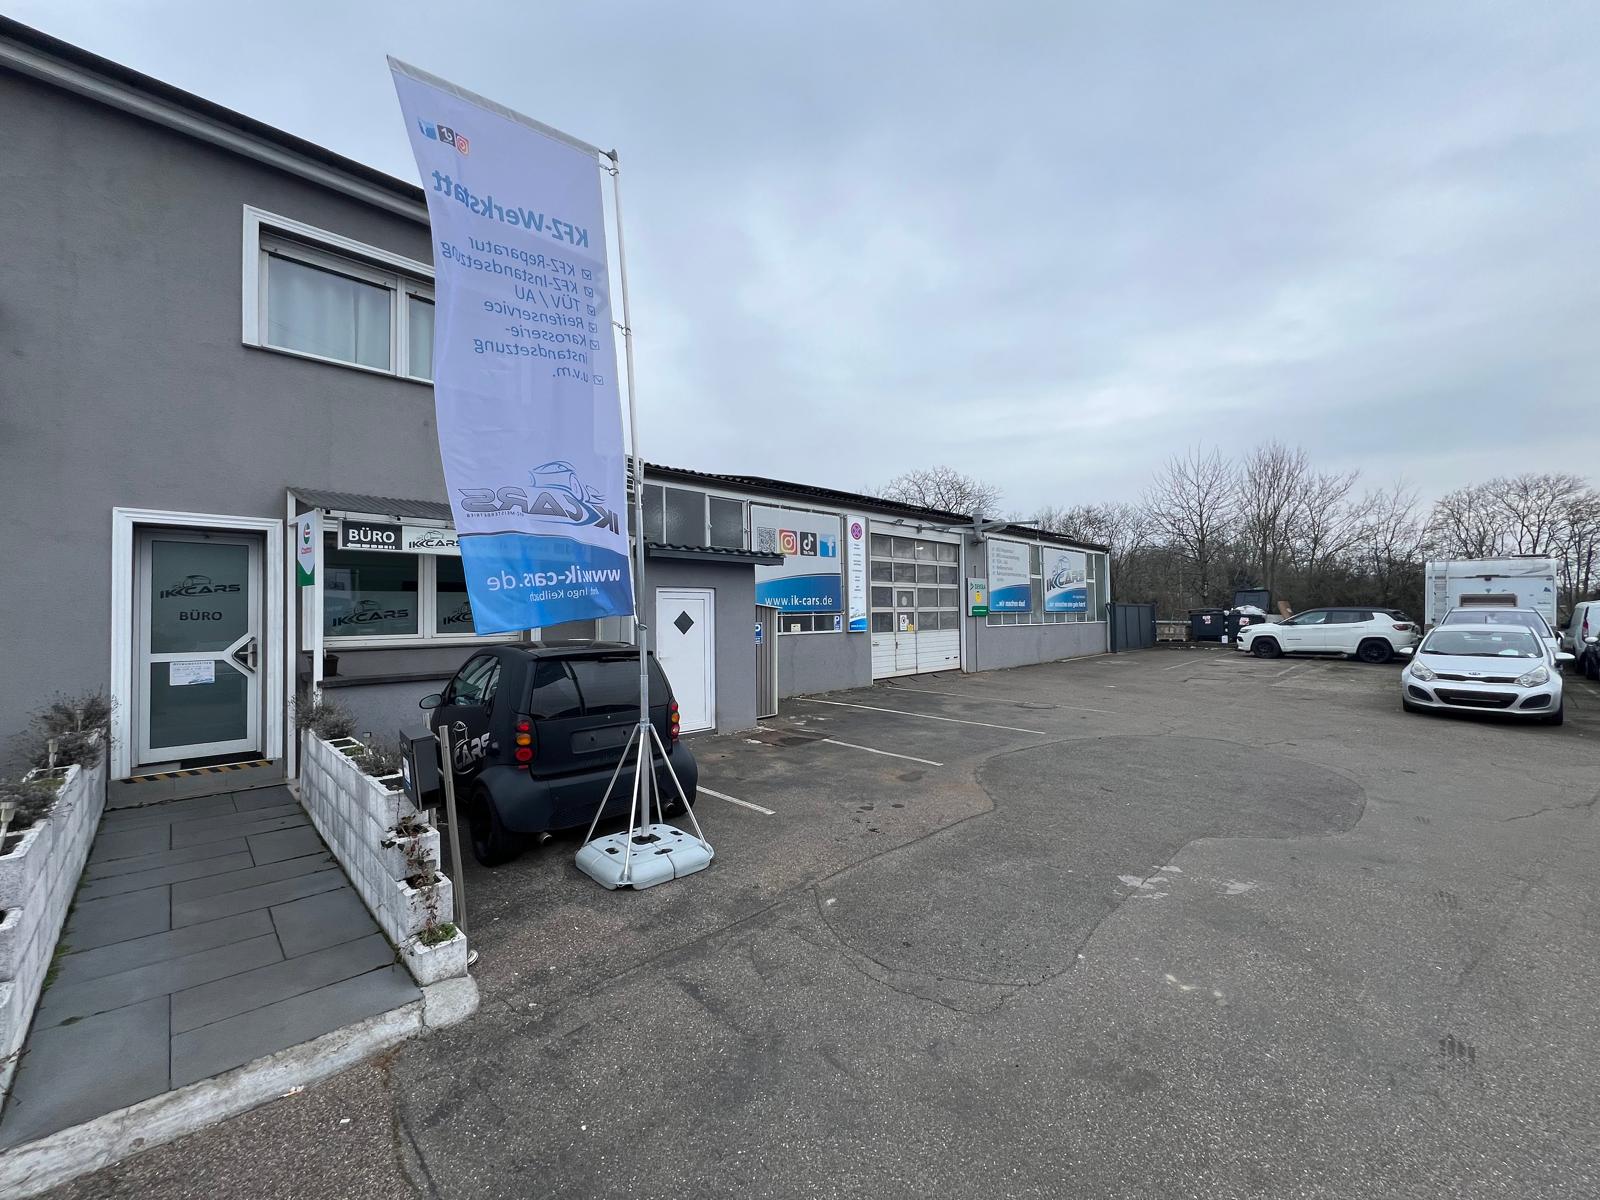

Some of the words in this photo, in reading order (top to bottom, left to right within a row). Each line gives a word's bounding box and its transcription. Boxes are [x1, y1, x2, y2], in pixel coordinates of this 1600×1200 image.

[349, 527, 395, 543] BÜRO
[765, 594, 833, 606] www.ik-cars.de
[179, 609, 223, 621] BÜRO
